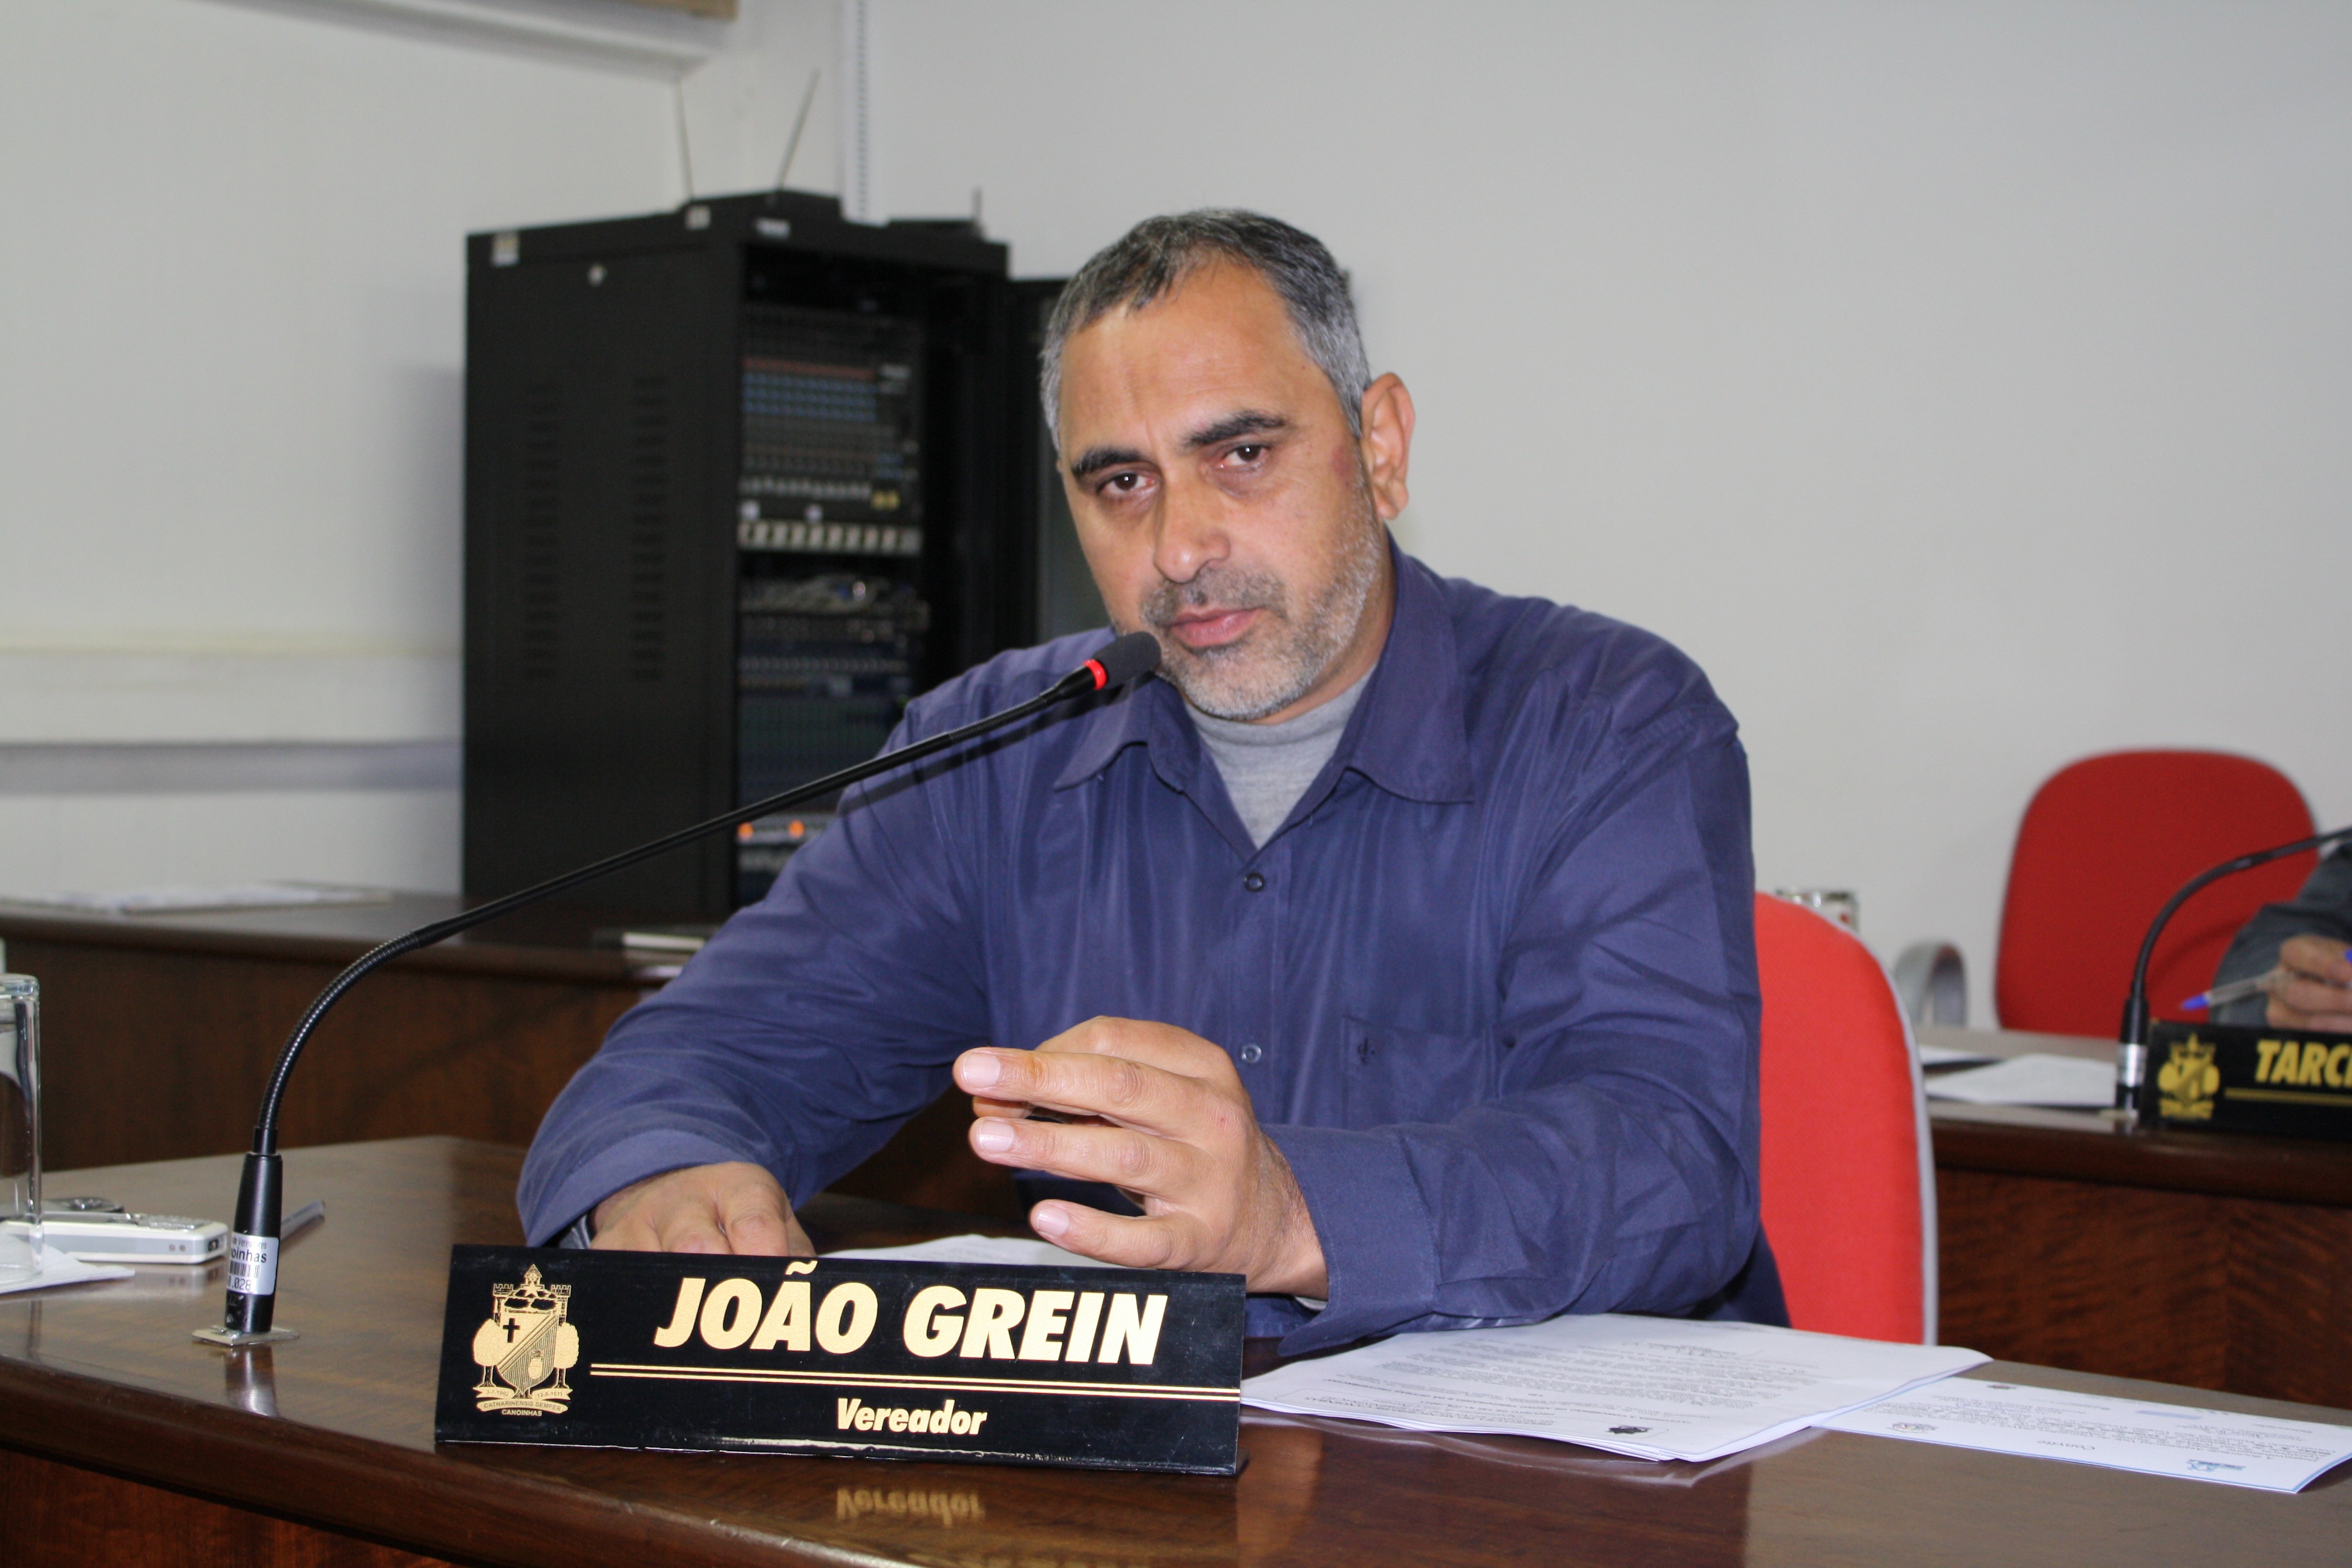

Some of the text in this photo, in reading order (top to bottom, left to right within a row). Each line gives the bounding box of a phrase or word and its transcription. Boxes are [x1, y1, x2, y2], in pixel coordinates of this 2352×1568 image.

[230, 1247, 267, 1263] oinhas
[654, 1260, 1168, 1365] JOÃO GREIN
[483, 1400, 561, 1411] CATHARINENSIS SEMPER
[837, 1398, 987, 1435] Vereador
